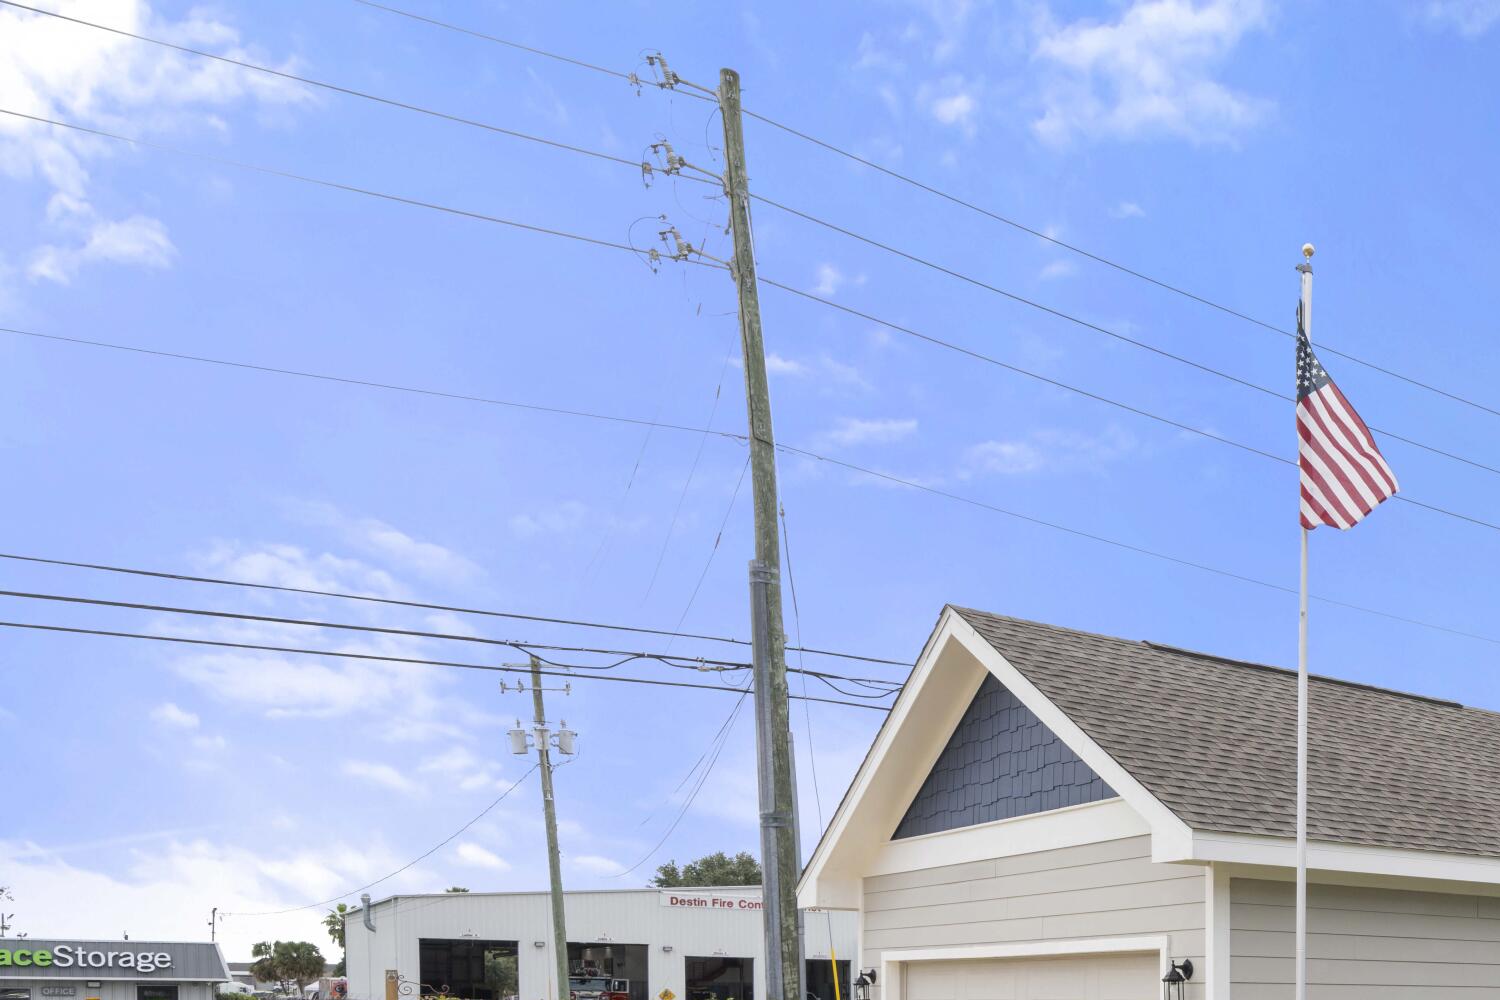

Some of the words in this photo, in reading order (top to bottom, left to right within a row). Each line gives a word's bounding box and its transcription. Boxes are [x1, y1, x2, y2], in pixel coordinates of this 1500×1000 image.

[670, 896, 707, 907] Destin
[712, 898, 734, 908] Fire
[43, 987, 75, 995] OFFICE
